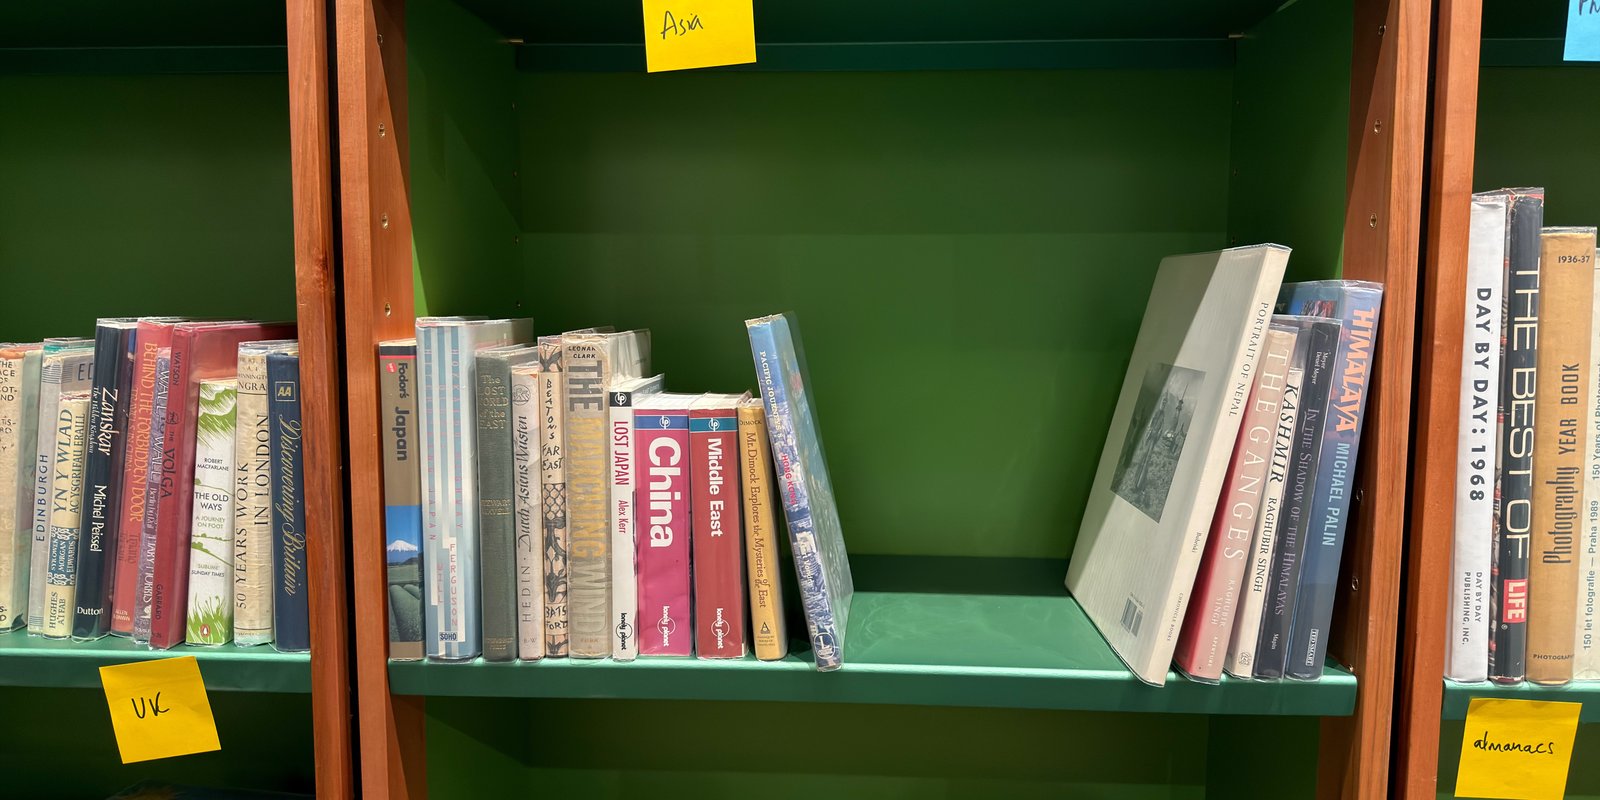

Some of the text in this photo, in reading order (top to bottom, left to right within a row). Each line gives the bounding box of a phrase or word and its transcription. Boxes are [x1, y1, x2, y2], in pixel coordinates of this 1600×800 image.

[660, 10, 704, 40] Asia
[1558, 255, 1591, 264] 1936-37
[141, 342, 158, 389] BEHIND
[173, 351, 182, 386] WATSON
[481, 374, 501, 384] The
[1228, 302, 1269, 417] PORTRAIT OF NEPAL
[1311, 367, 1320, 385] Meyer
[1333, 307, 1376, 433] HIMALAYA
[92, 386, 101, 399] The
[138, 391, 153, 415] THE
[277, 386, 292, 397] AA
[567, 360, 604, 413] THE
[759, 351, 773, 386] PACIFIC
[767, 385, 783, 433] JOURNEYS
[1469, 287, 1492, 502] DAY BY DAY: 1968
[90, 400, 100, 424] Hidden
[98, 386, 120, 457] Zanskar
[391, 362, 410, 462] Fodor's Japan
[545, 378, 558, 440] BEATON'S
[132, 417, 152, 485] FORBIDDEN
[542, 443, 560, 456] FAR
[613, 421, 629, 448] LOST
[1224, 349, 1290, 561] THE GANGES
[1506, 257, 1541, 620] THE BEST OF LIFE
[53, 408, 73, 513] YN Y WLAD
[69, 499, 79, 514] AC
[74, 413, 85, 447] ERAILL
[150, 435, 165, 482] WALL
[161, 447, 176, 498] VOLGA
[197, 463, 229, 471] MACFARLANE
[204, 457, 223, 465] ROBERT
[254, 414, 270, 526] IN LONDON
[542, 457, 564, 471] EAST
[614, 451, 629, 486] JAPAN
[707, 438, 724, 495] Middle
[781, 453, 793, 480] HONG
[1293, 452, 1312, 503] SHADOW
[1542, 363, 1580, 564] Photography YEAR BOOK
[1591, 463, 1600, 481] 150
[36, 454, 48, 542] EDINBURGH
[129, 485, 146, 523] DOOR
[194, 491, 229, 502] THE OLD
[200, 502, 223, 511] WAYS
[275, 413, 306, 596] Discovering Britain
[516, 464, 533, 508] Asiens
[569, 417, 607, 559] MARCHING
[648, 436, 682, 548] China
[1253, 383, 1300, 593] KASHMIR RAGHUBIR SINGH
[1322, 442, 1351, 547] MICHAEL PALIN
[90, 484, 108, 552] Michel Peissel
[200, 515, 226, 523] JOURNEY
[428, 488, 437, 541] JAPAN
[516, 508, 532, 553] Durch
[618, 500, 629, 534] Alex Kerr
[709, 500, 724, 537] East
[746, 432, 770, 587] Mr. Dimock Explores the Mysteries of
[1291, 506, 1300, 521] OF
[58, 540, 66, 572] MORGAN
[66, 540, 76, 573] EDWARDS
[235, 462, 249, 609] 50 YEARS WORK
[1286, 526, 1297, 549] THE
[449, 543, 458, 626] FERGUSON
[521, 565, 532, 623] HEDIN
[1274, 551, 1296, 616] HIMALAYAS
[1474, 571, 1483, 623] DAY BY DAY
[1583, 500, 1598, 650] 150 let fotografie Praha 1989
[49, 591, 58, 629] HUGHES
[77, 606, 104, 616] Dutton
[155, 583, 163, 620] GARRARD
[572, 561, 607, 634] WIND
[758, 589, 768, 608] East
[1166, 592, 1184, 642] CHRONICLE BOOKS
[1211, 596, 1224, 626] SINGH
[1461, 571, 1471, 646] PUBLISHING, INC.
[439, 632, 457, 641] SOHO
[619, 612, 628, 651] lonely planet
[661, 605, 670, 647] lonely planet
[715, 607, 724, 649] lonely planet
[1208, 636, 1219, 667] APERTURE
[131, 691, 170, 719] UK
[1473, 730, 1555, 755] almanacs
